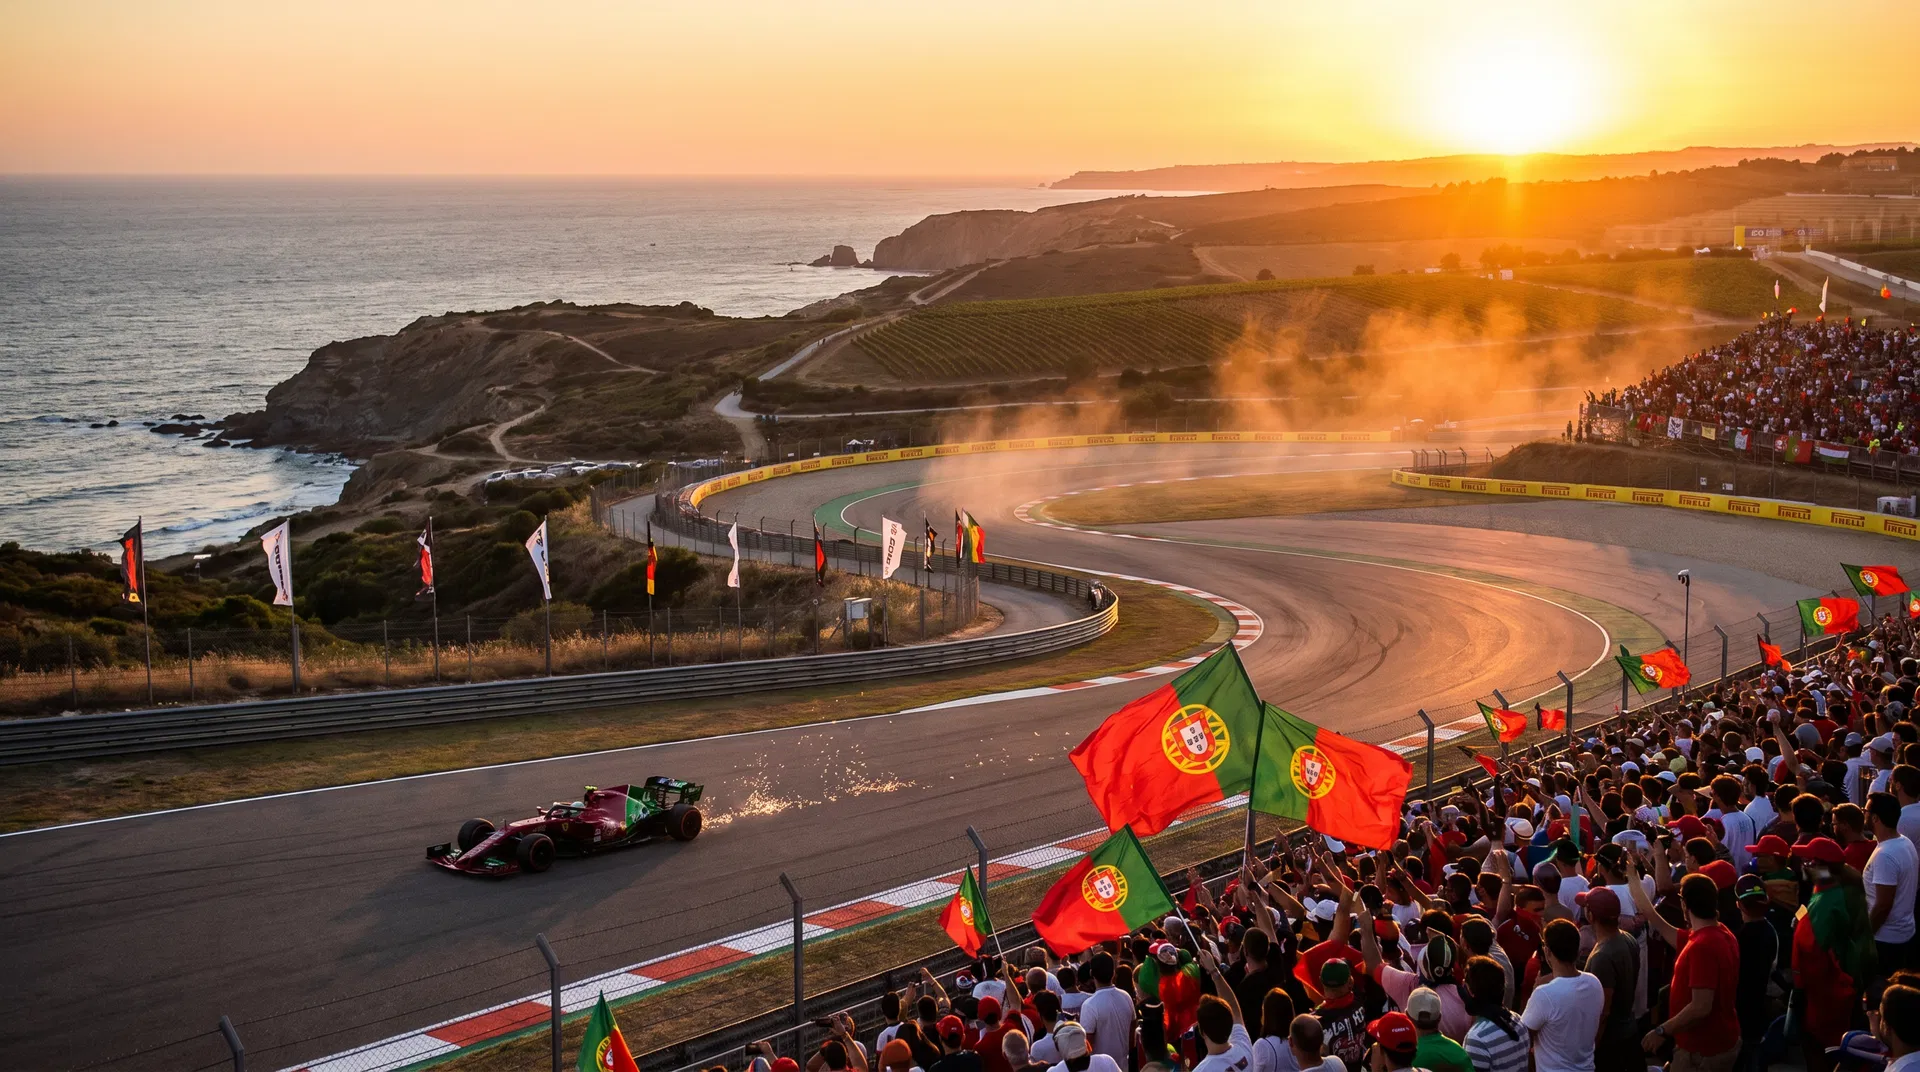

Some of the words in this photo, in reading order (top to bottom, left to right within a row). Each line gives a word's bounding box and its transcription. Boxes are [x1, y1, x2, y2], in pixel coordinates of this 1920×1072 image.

[1586, 487, 1616, 500] PIRELLI
[1632, 491, 1664, 504] PIRELLI
[1679, 494, 1711, 508] PIRELLI
[1728, 500, 1761, 514] PIRELLI
[1778, 505, 1811, 521] PIRELLI
[1831, 511, 1865, 528] PIRELLI
[1884, 519, 1917, 537] PIRELLI
